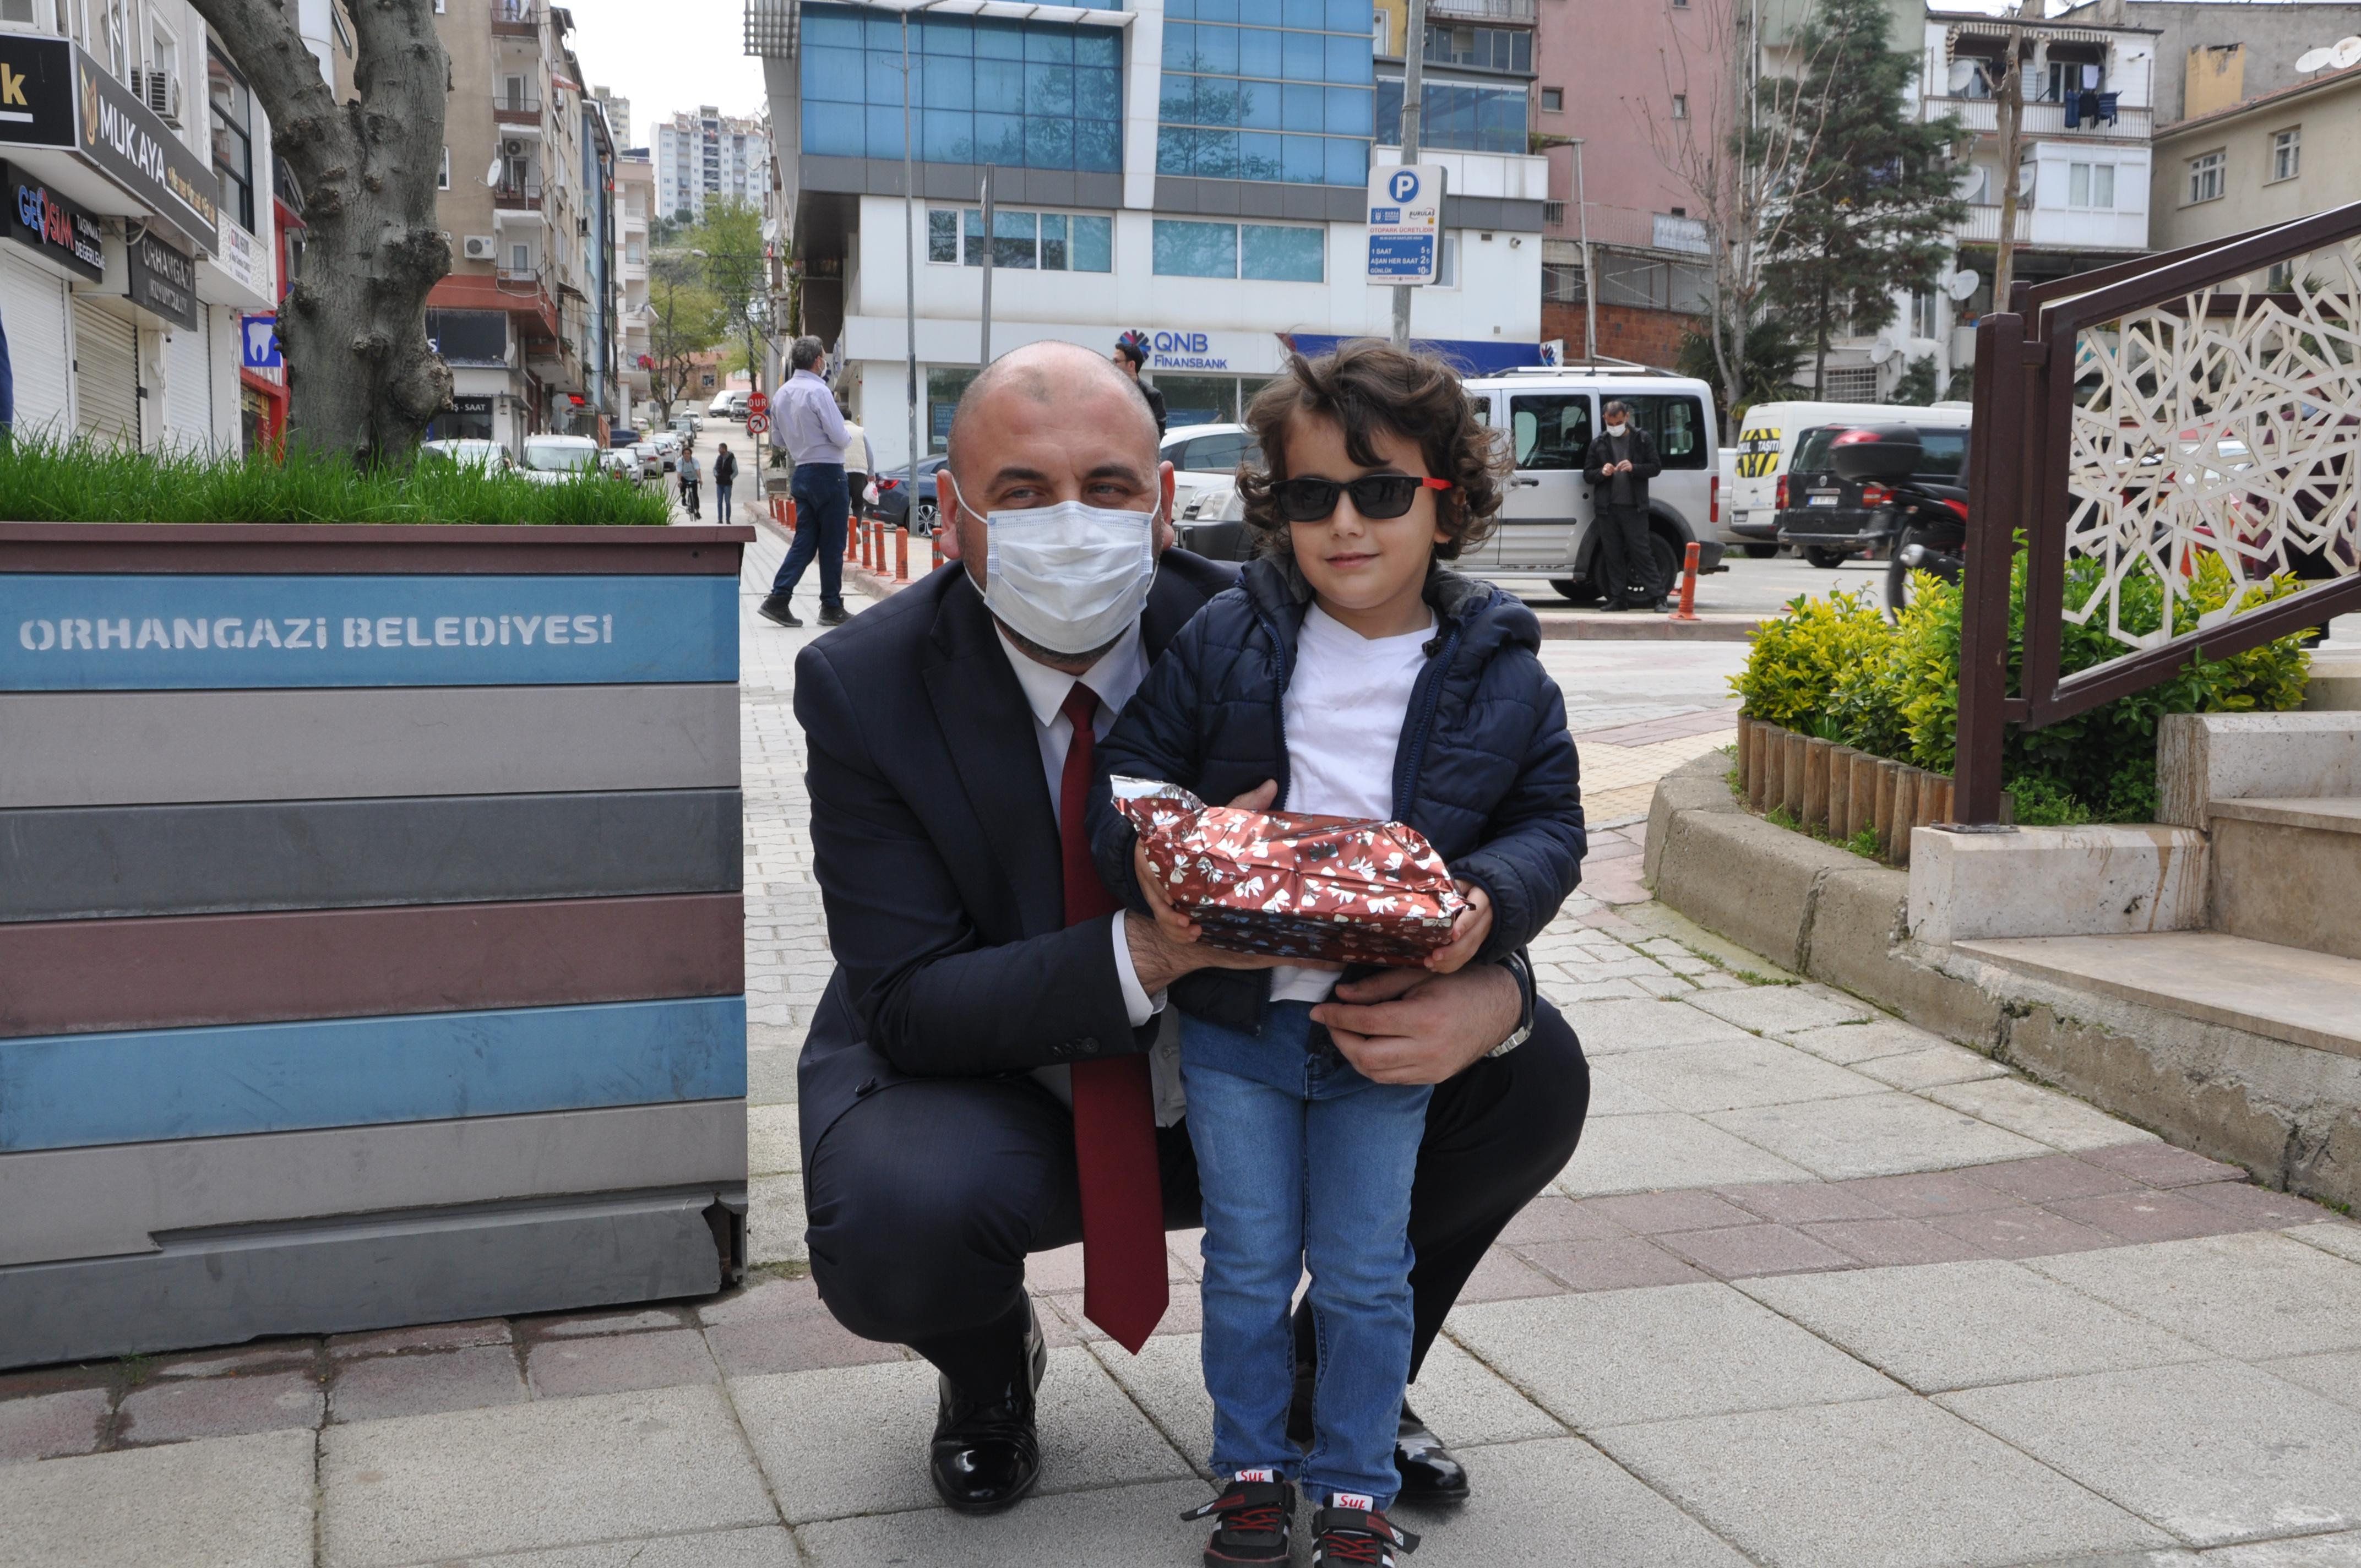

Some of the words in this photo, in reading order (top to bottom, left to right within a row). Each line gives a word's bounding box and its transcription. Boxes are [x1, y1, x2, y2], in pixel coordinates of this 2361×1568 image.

[100, 94, 167, 189] MUKAYA
[1396, 176, 1414, 198] P
[75, 239, 106, 270] DEĞERLEME
[1155, 331, 1209, 353] QNB
[749, 398, 766, 407] DUR
